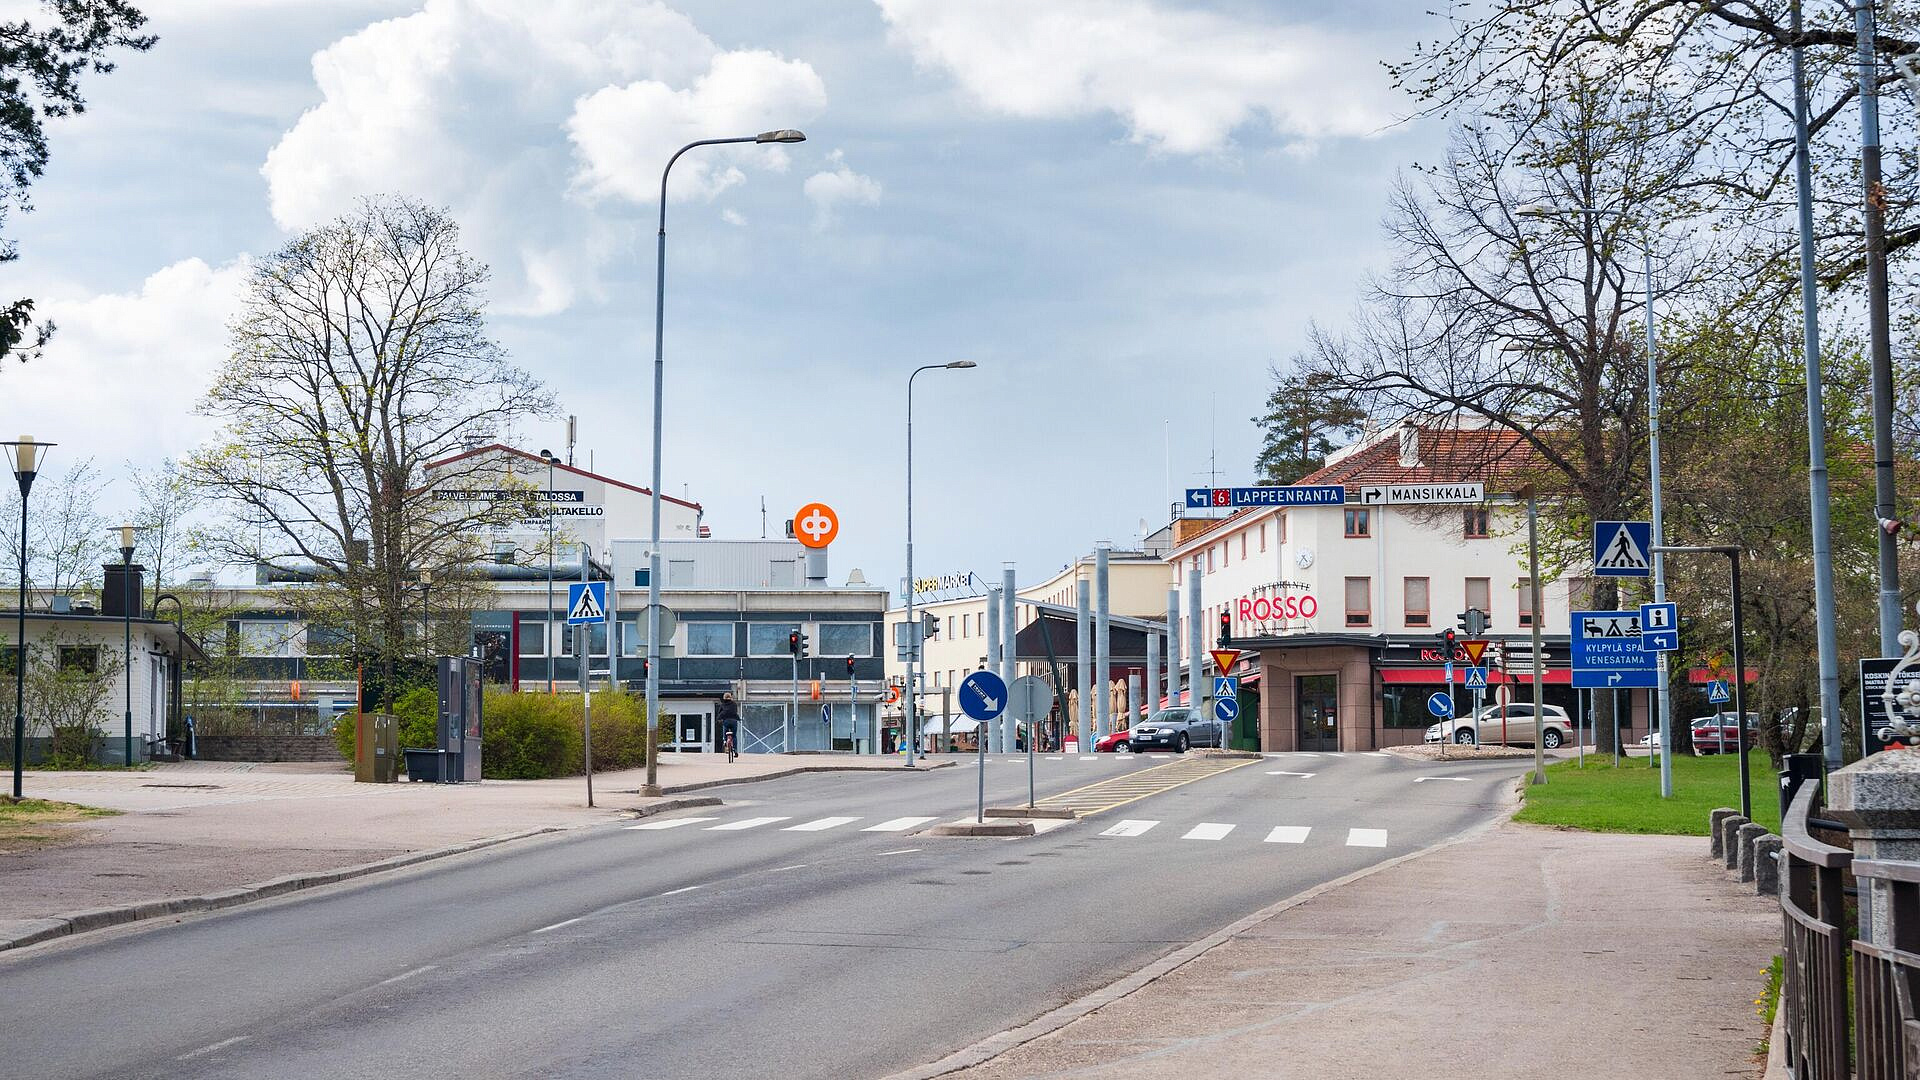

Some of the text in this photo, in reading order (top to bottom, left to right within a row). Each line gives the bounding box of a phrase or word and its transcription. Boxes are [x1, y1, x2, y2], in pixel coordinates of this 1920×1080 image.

[535, 492, 577, 502] TALOSSA
[1218, 489, 1339, 504] 6 LAPPEENRANTA
[1392, 486, 1477, 501] MANSIKKALA
[913, 573, 970, 594] SUPERMARKET
[1239, 595, 1318, 621] ROSSO
[1585, 642, 1643, 653] KYLPYLÄ SPA
[1585, 655, 1645, 665] VENESATAMA
